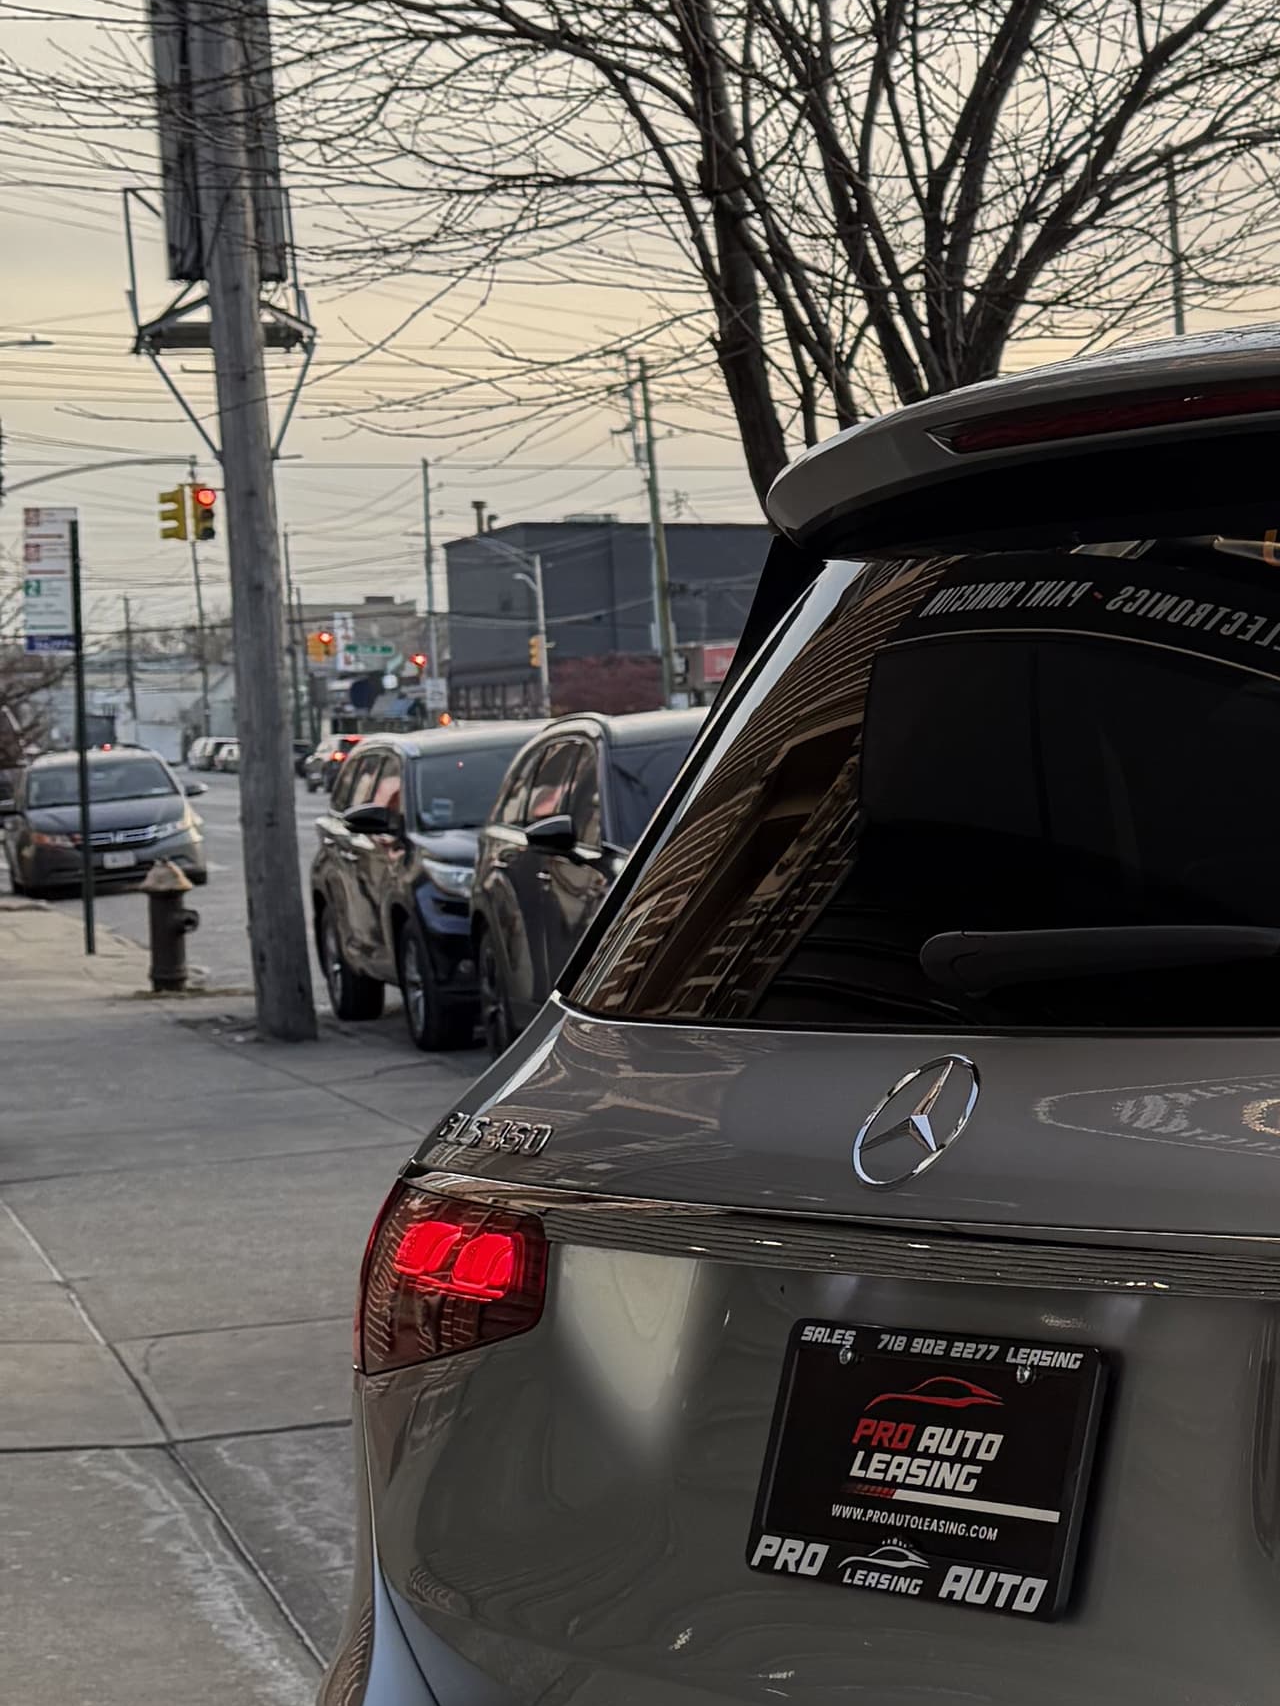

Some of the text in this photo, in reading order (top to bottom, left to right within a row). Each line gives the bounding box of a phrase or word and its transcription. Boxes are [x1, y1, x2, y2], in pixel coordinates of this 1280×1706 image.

[800, 1325, 1084, 1370] SALES 718 902 2277 LEASING
[851, 1417, 1004, 1462] PRO AUTO
[849, 1450, 983, 1493] LEASING
[831, 1503, 999, 1542] WWW.PROAUTOLEASING.COM
[750, 1534, 1049, 1614] PRO AUTO
[842, 1567, 924, 1596] LEASING
